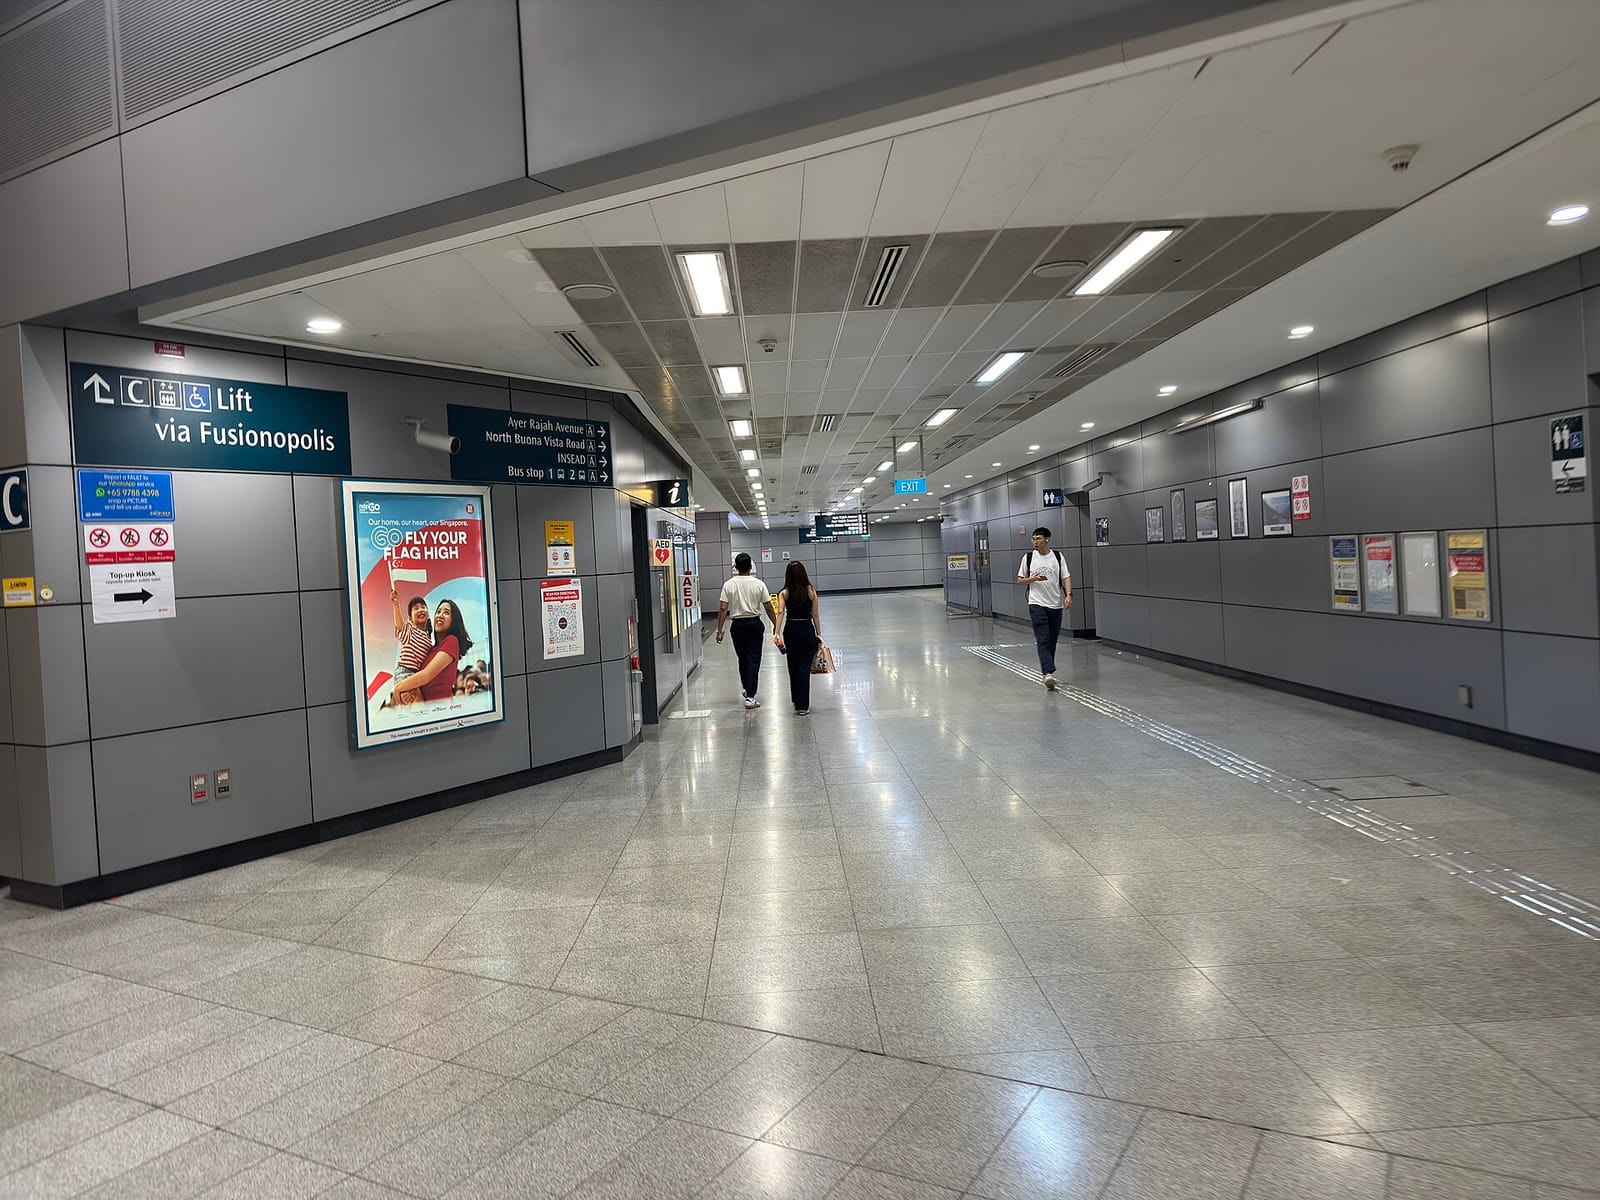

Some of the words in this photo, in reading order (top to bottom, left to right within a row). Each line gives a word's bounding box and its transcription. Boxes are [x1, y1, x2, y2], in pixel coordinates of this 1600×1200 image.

[127, 379, 144, 404] C
[217, 387, 253, 413] Lift
[507, 416, 527, 430] Ayer
[529, 419, 553, 433] Rajah
[555, 422, 584, 434] Avenue
[587, 426, 594, 435] A
[154, 417, 191, 443] via
[200, 421, 335, 454] Fusionopolis
[485, 431, 512, 443] North
[514, 433, 542, 446] Buona
[544, 436, 564, 448] Vista
[566, 438, 585, 450] Road
[588, 441, 594, 450] A
[557, 453, 586, 465] INSEAD
[589, 456, 595, 466] A
[103, 474, 121, 482] Report
[508, 465, 525, 477] Bus
[526, 467, 544, 479] stop
[548, 468, 553, 479] 1
[569, 469, 576, 480] 2
[590, 471, 596, 481] A
[108, 480, 136, 488] WhatsApp
[901, 481, 919, 492] EXIT
[107, 489, 121, 498] +65
[122, 488, 141, 498] 9788
[2, 476, 23, 526] C
[368, 518, 380, 526] Our
[381, 519, 401, 527] home,
[411, 519, 429, 527] heart,
[440, 520, 469, 528] Singapore.
[405, 531, 429, 545] FLY
[429, 531, 468, 545] YOUR
[655, 541, 670, 549] AED
[383, 546, 421, 561] FLAG
[424, 546, 459, 560] HIGH
[110, 571, 135, 580] Top-up
[136, 570, 156, 578] Kiosk
[682, 576, 693, 608] AED
